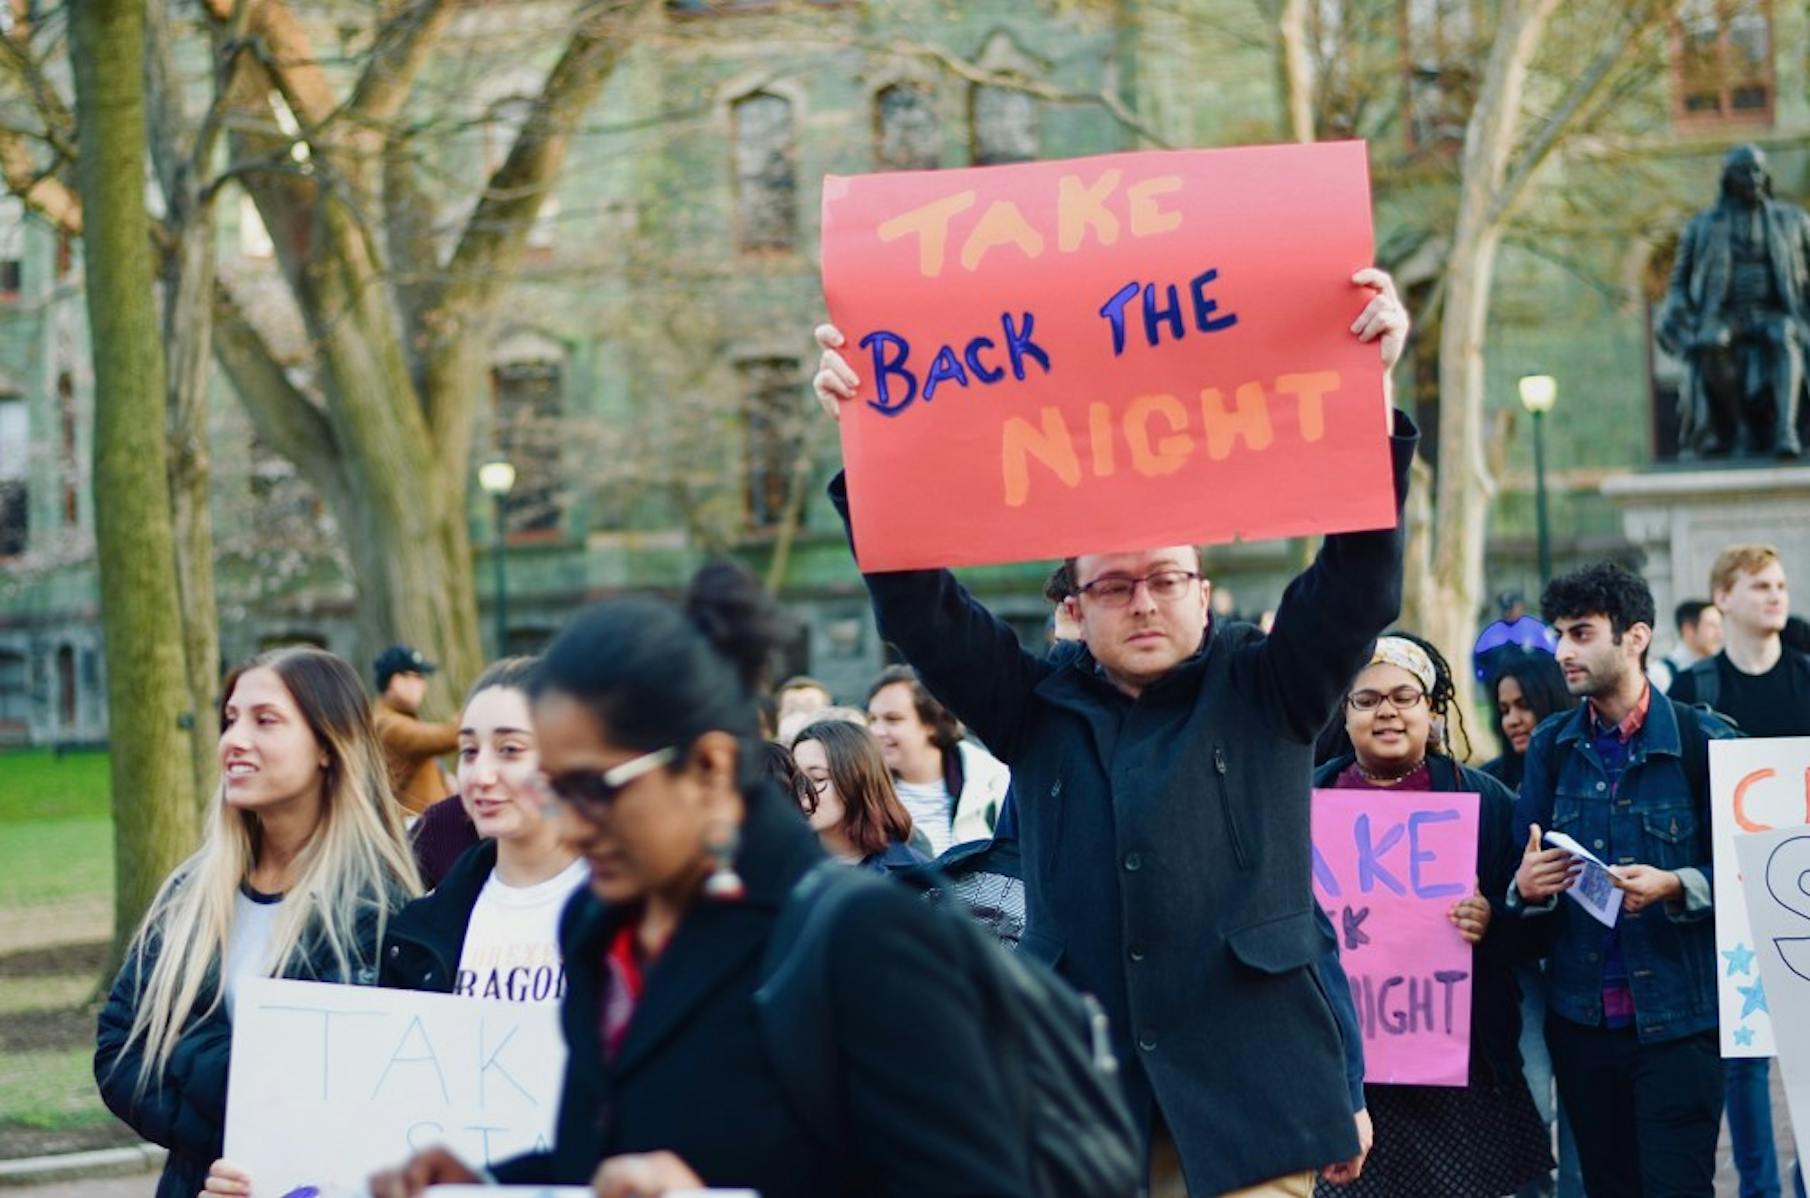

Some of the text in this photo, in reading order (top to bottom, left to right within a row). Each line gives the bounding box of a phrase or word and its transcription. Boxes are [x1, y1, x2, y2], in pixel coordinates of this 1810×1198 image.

[877, 168, 1184, 278] TAKE
[858, 267, 1239, 418] BACK THE
[1002, 370, 1341, 507] NIGHT
[258, 1005, 539, 1110] TAK
